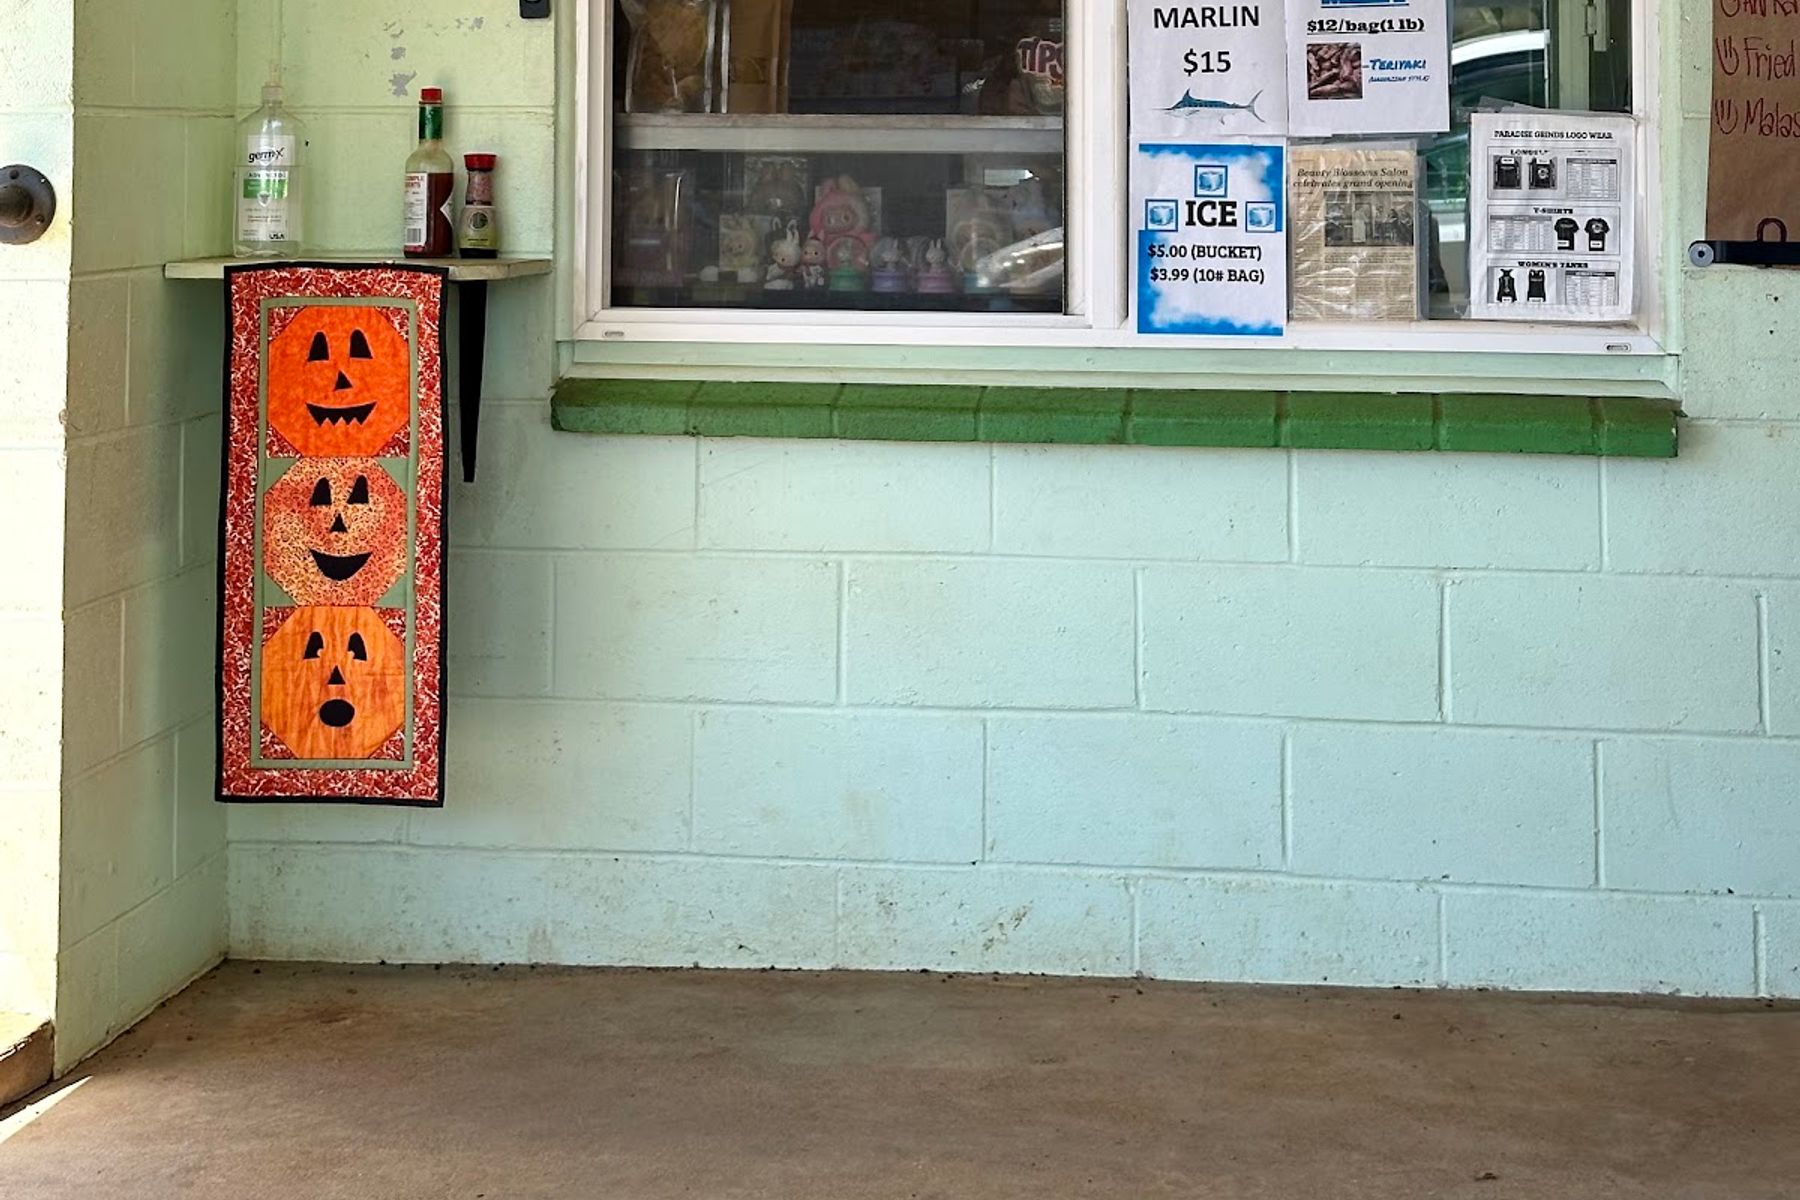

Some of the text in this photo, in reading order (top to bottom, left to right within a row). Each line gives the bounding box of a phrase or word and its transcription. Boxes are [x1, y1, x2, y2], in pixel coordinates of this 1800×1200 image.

[1154, 6, 1260, 29] MARLIN
[1307, 17, 1424, 33] $12/bag(1 lb)
[1183, 48, 1231, 76] $15
[1369, 59, 1426, 70] TERIYAKI
[1744, 37, 1795, 81] Fried
[1185, 201, 1237, 227] ICE
[1148, 244, 1262, 261] $5.00 (BUCKET)
[1150, 268, 1265, 284] $3.99 (10# BAG)
